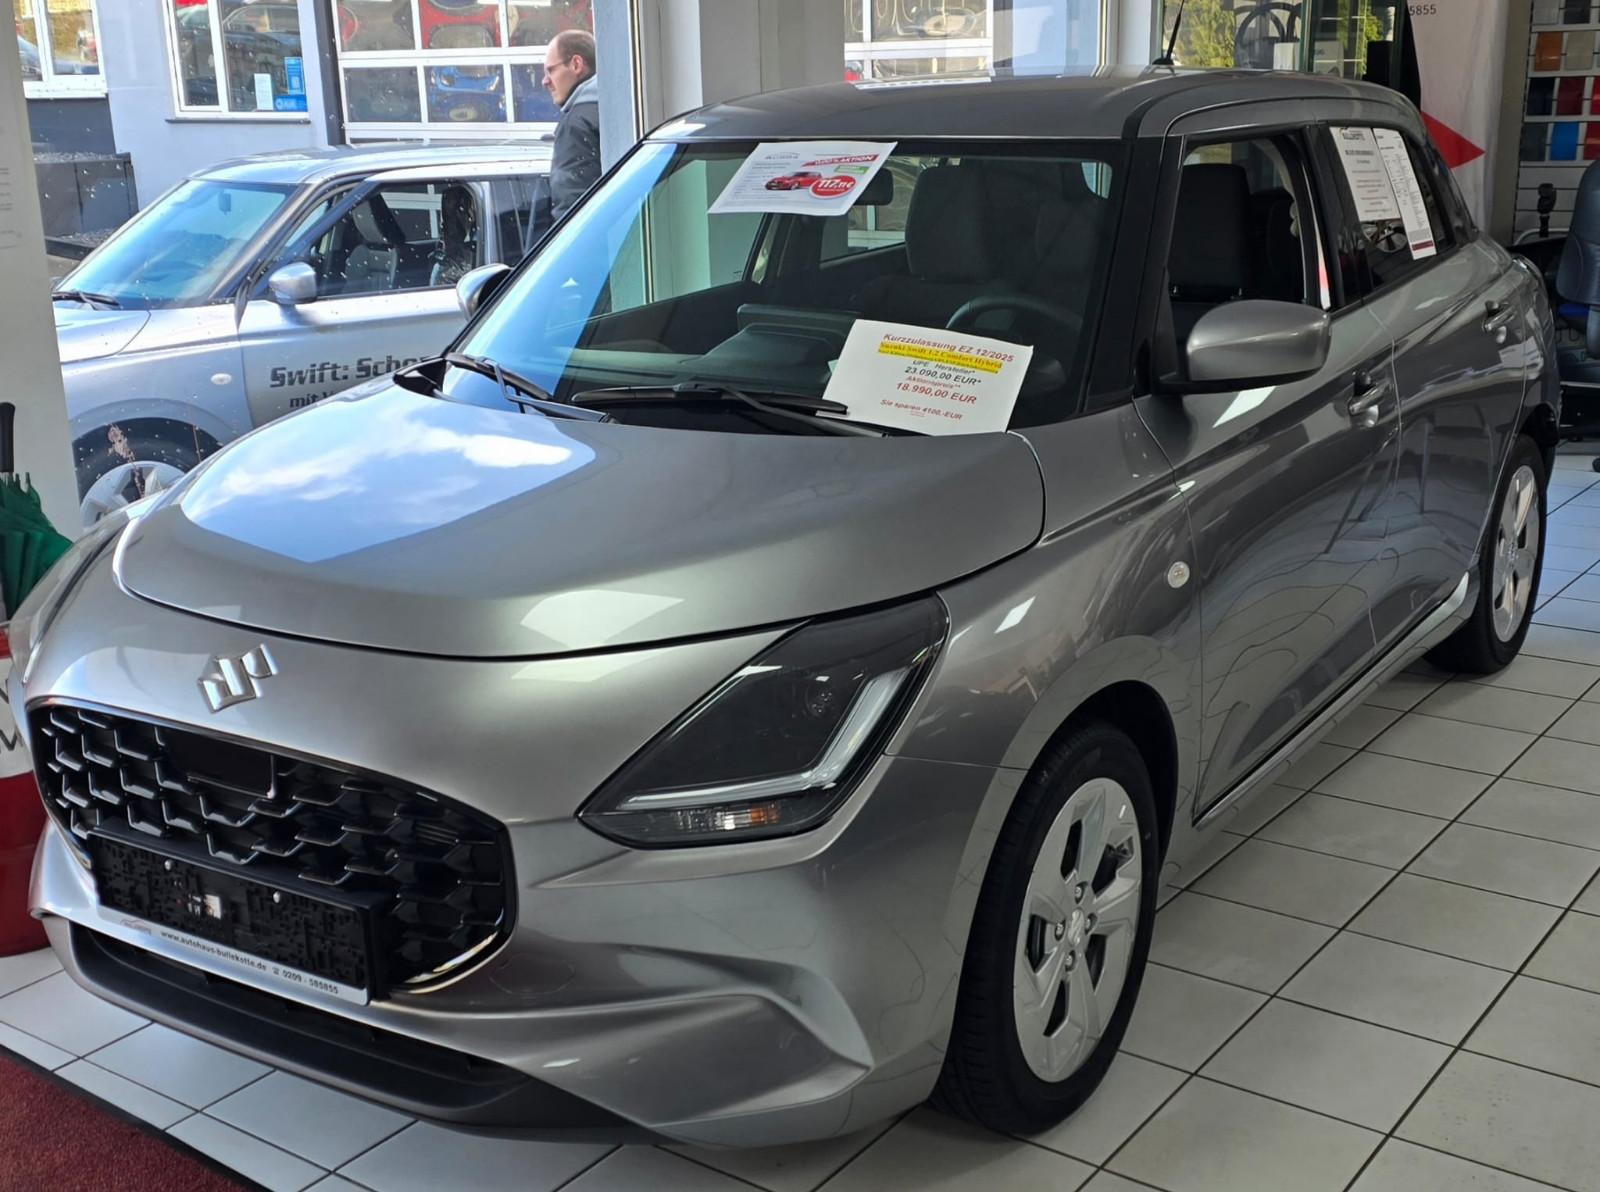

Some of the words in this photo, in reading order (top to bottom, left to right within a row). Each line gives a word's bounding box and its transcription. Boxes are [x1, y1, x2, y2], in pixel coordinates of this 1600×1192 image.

[883, 333, 957, 351] Kurzzulassung
[957, 345, 974, 354] EZ
[976, 348, 1014, 362] 12/2025
[270, 362, 349, 387] Swift:
[356, 355, 430, 378] Scho
[904, 366, 952, 380] 23.090,00
[974, 356, 1002, 369] Hybrid
[896, 382, 949, 398] 18.990,00
[950, 393, 977, 404] EUR
